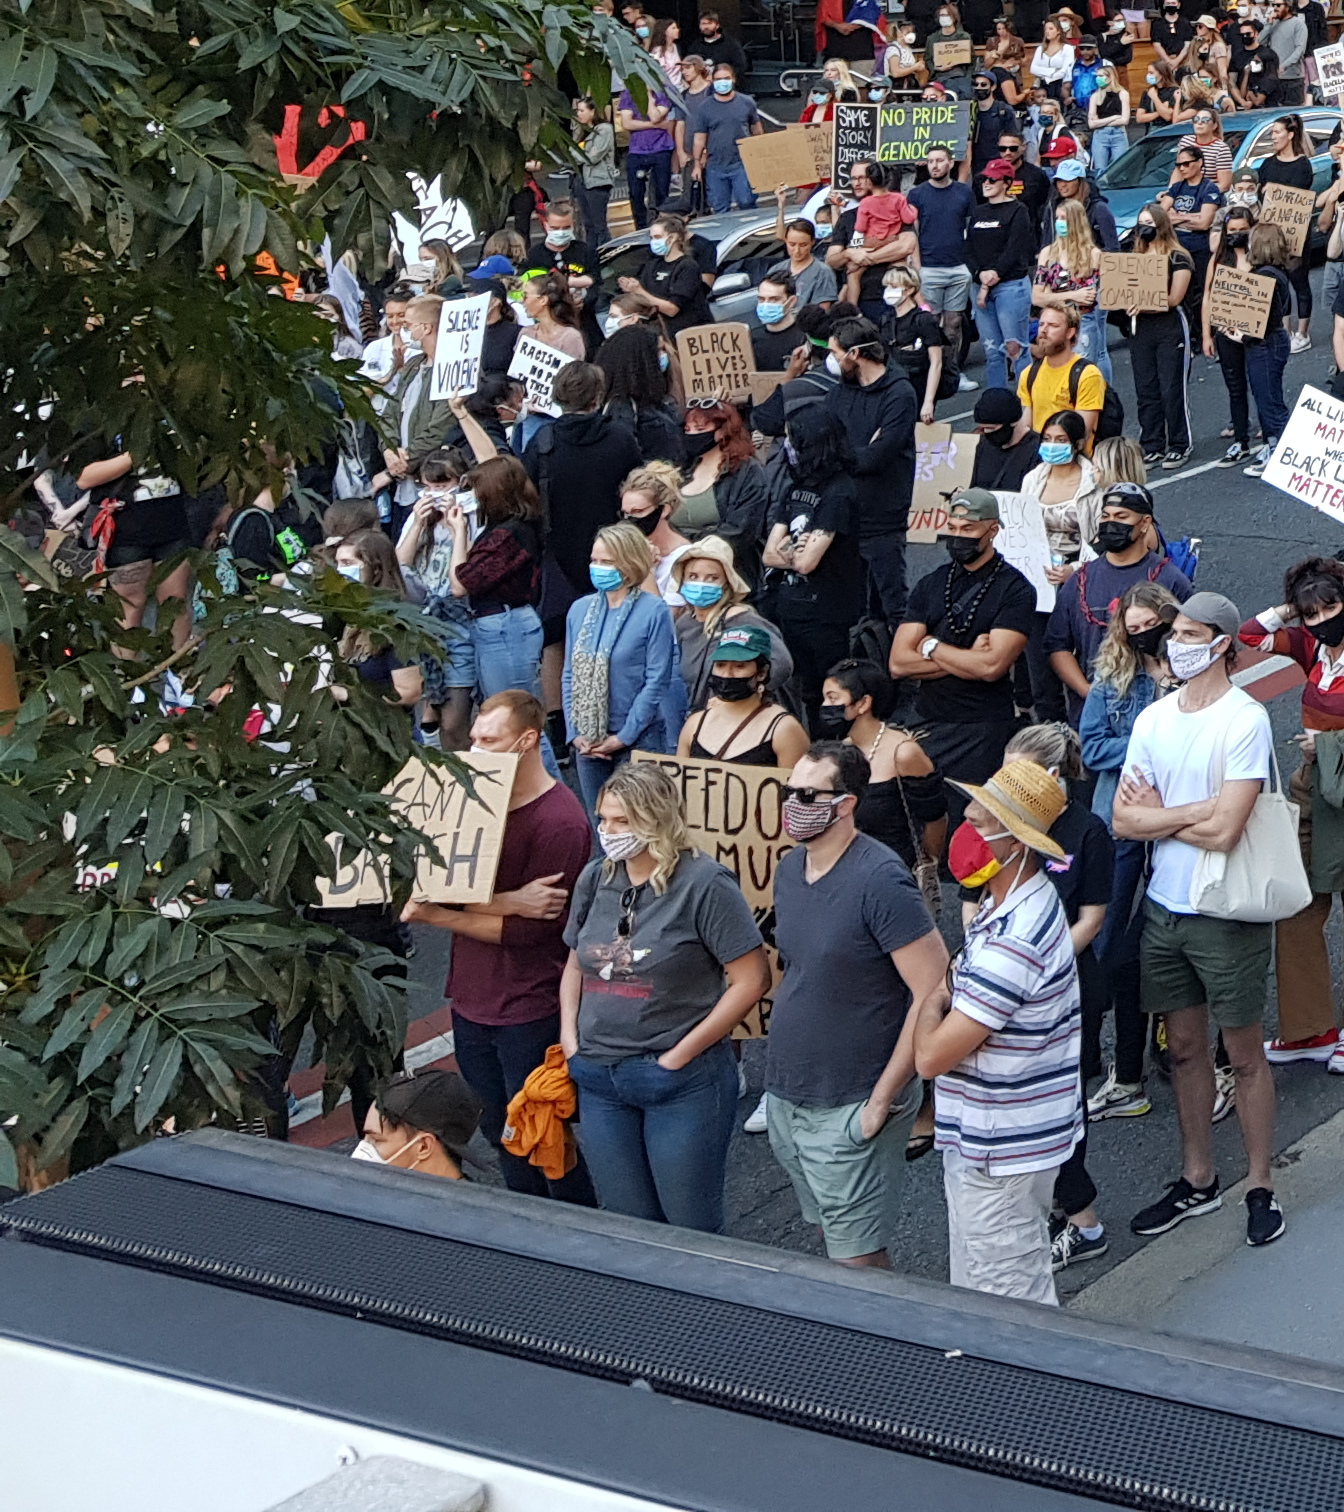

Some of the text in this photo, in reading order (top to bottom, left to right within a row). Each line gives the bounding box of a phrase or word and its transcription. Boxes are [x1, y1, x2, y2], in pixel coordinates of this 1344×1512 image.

[838, 108, 871, 128] SAME
[880, 105, 959, 127] NO PRIDE
[838, 129, 872, 148] STORY
[914, 125, 930, 140] IN
[879, 140, 959, 163] GENOCE
[1101, 256, 1163, 276] SILENCE
[1227, 270, 1242, 280] YOU
[1100, 288, 1168, 308] COMPLIANCE
[446, 308, 481, 334] SILENCE
[459, 333, 470, 354] IS
[687, 332, 742, 357] BLACK
[520, 342, 562, 369] RACISM
[692, 355, 747, 376] LIVES
[438, 357, 479, 393] VIOLENCE
[529, 365, 543, 379] NO
[530, 379, 550, 396] THIS
[692, 373, 751, 394] MATTER
[1301, 398, 1323, 416] ALL
[1280, 447, 1331, 478] BLACK
[1001, 497, 1031, 527] ACK
[1000, 526, 1029, 548] VES
[638, 759, 790, 840] EEDO
